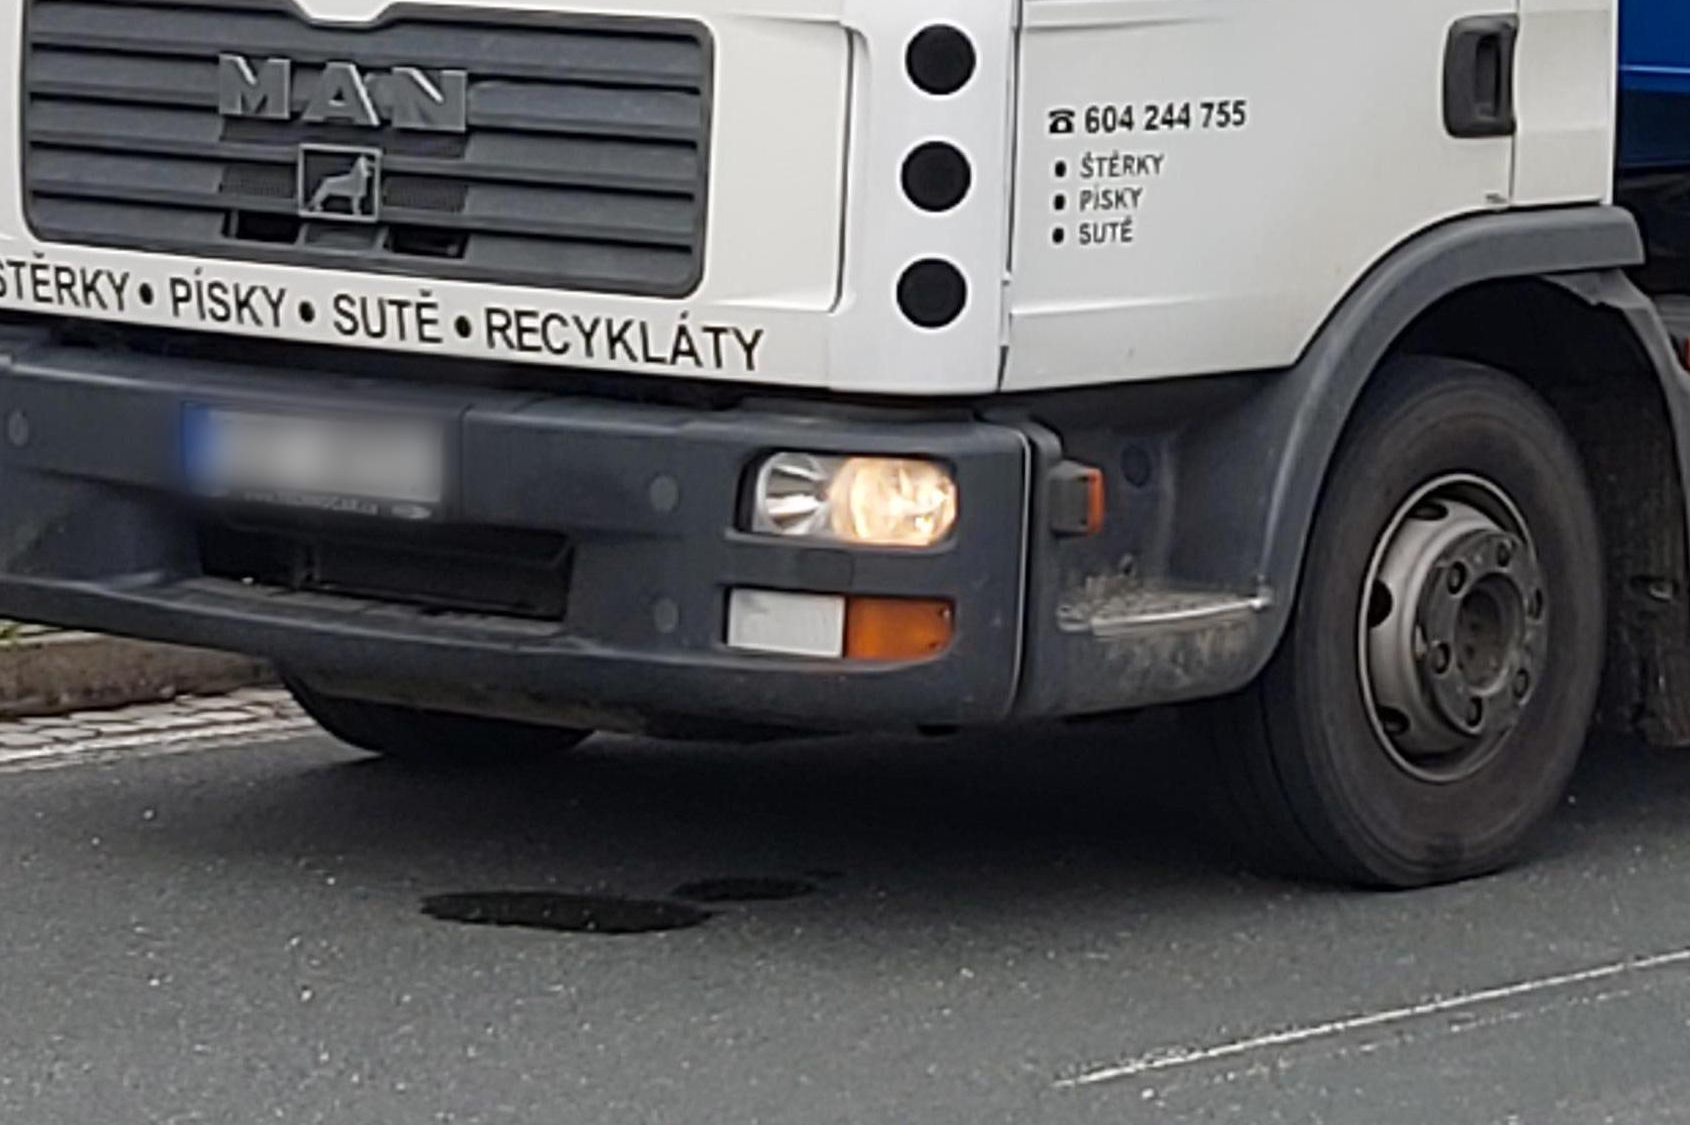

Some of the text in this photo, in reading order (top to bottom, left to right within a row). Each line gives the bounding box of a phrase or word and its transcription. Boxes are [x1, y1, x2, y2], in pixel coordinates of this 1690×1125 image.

[218, 52, 468, 133] MAN
[1084, 99, 1247, 134] 604 244 755
[1078, 184, 1143, 212] PÍSKY
[169, 266, 287, 328] PÍSKY
[332, 289, 443, 344] SUTĚ
[484, 310, 764, 371] RECYKLÁTY
